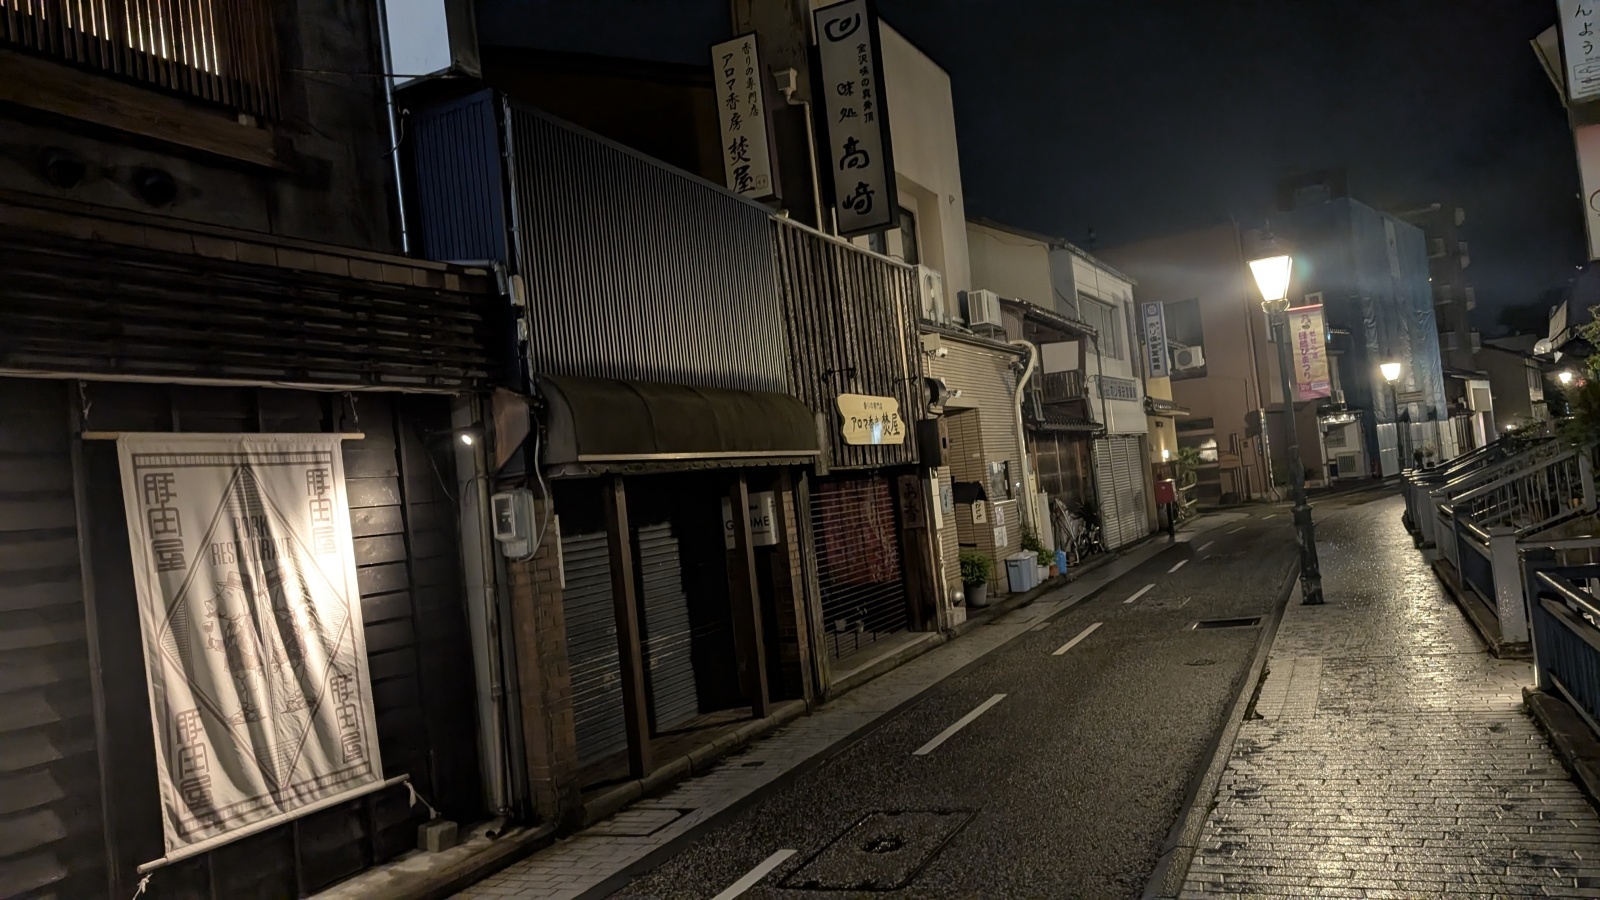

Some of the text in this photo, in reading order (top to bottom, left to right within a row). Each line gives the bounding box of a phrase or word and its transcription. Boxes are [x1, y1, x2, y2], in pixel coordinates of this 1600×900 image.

[741, 42, 759, 117] 香りの専門店
[856, 43, 874, 124] 金沢味の真骨頂
[232, 516, 270, 539] PORK
